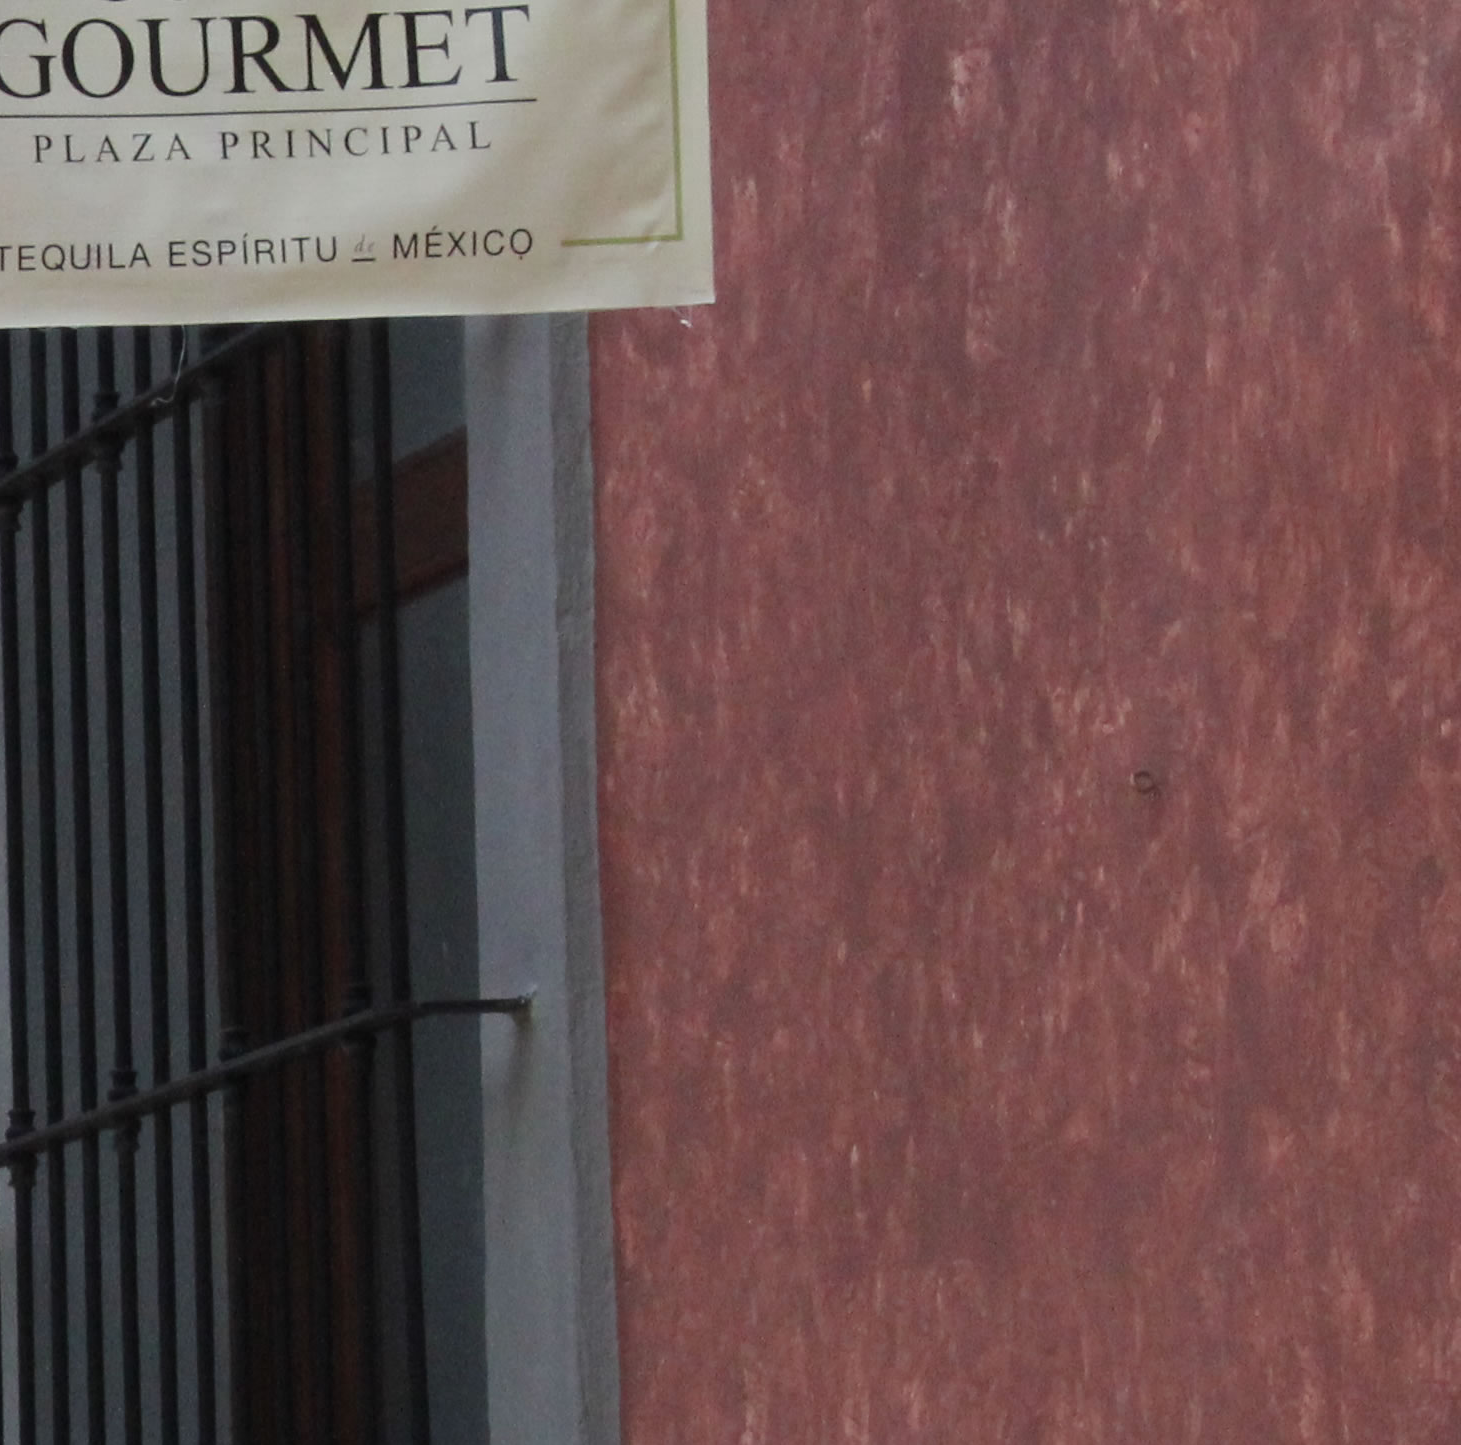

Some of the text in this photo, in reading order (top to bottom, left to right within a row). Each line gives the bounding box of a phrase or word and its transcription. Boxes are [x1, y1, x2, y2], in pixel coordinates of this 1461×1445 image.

[33, 120, 493, 164] PLAZA PRINCIPAL
[167, 231, 339, 268] ESPÍRITU
[393, 226, 533, 260] MÉXICO
